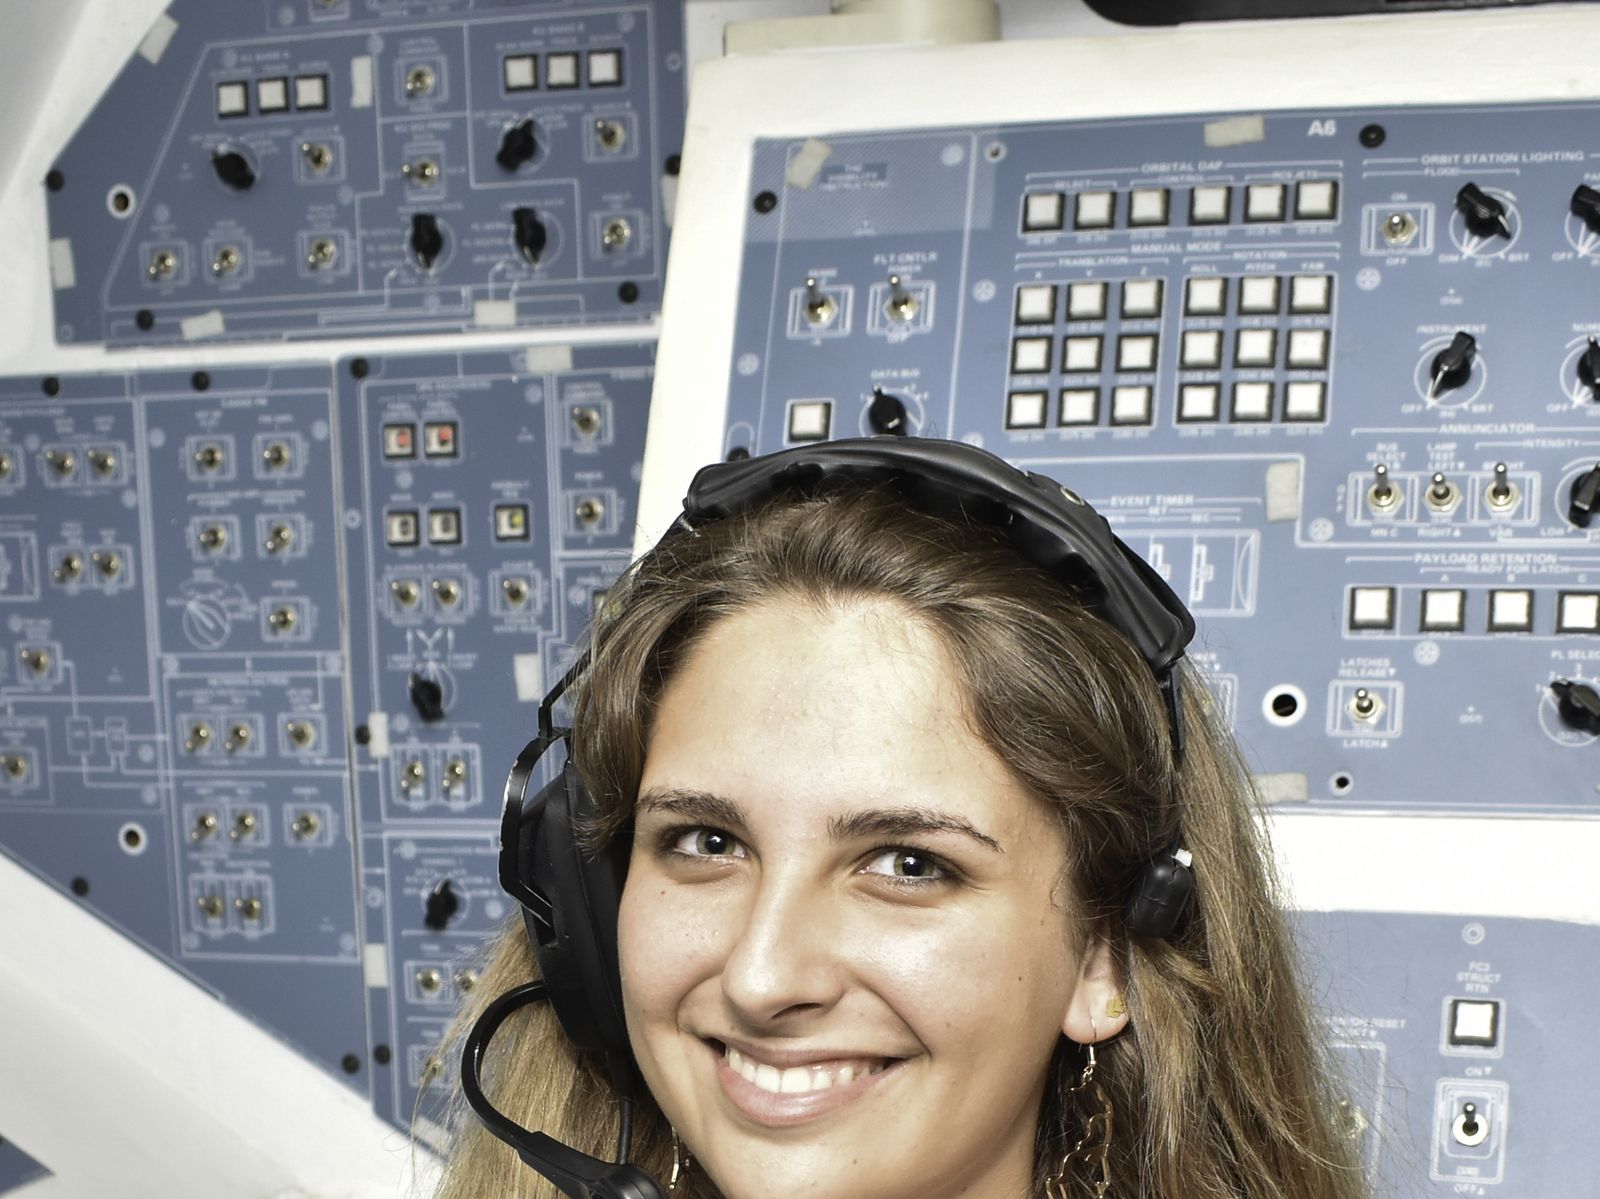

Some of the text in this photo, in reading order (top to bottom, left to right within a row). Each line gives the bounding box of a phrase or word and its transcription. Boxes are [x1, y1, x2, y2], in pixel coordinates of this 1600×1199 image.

[1307, 119, 1336, 136] A6
[1421, 150, 1584, 165] ORBIT STATION LIGHTING
[1141, 162, 1193, 173] ORBITAL
[1131, 241, 1222, 254] MANUAL MODE
[1058, 256, 1128, 266] TRANSLATION
[1416, 324, 1488, 334] INSTRUMENT
[1439, 423, 1536, 435] ANNUNCIATOR
[1522, 438, 1581, 448] INTENSITY
[1110, 494, 1194, 506] EVENT TIMER
[1414, 553, 1557, 565] PAYLOAD RETENTION
[1340, 658, 1391, 668] LATCHES
[1338, 668, 1389, 678] RELEASE
[1343, 739, 1379, 749] LATCH
[1457, 973, 1501, 983] STRUCT
[1465, 984, 1490, 993] RTN
[1465, 1067, 1482, 1076] ON
[1454, 1184, 1477, 1194] OFF
